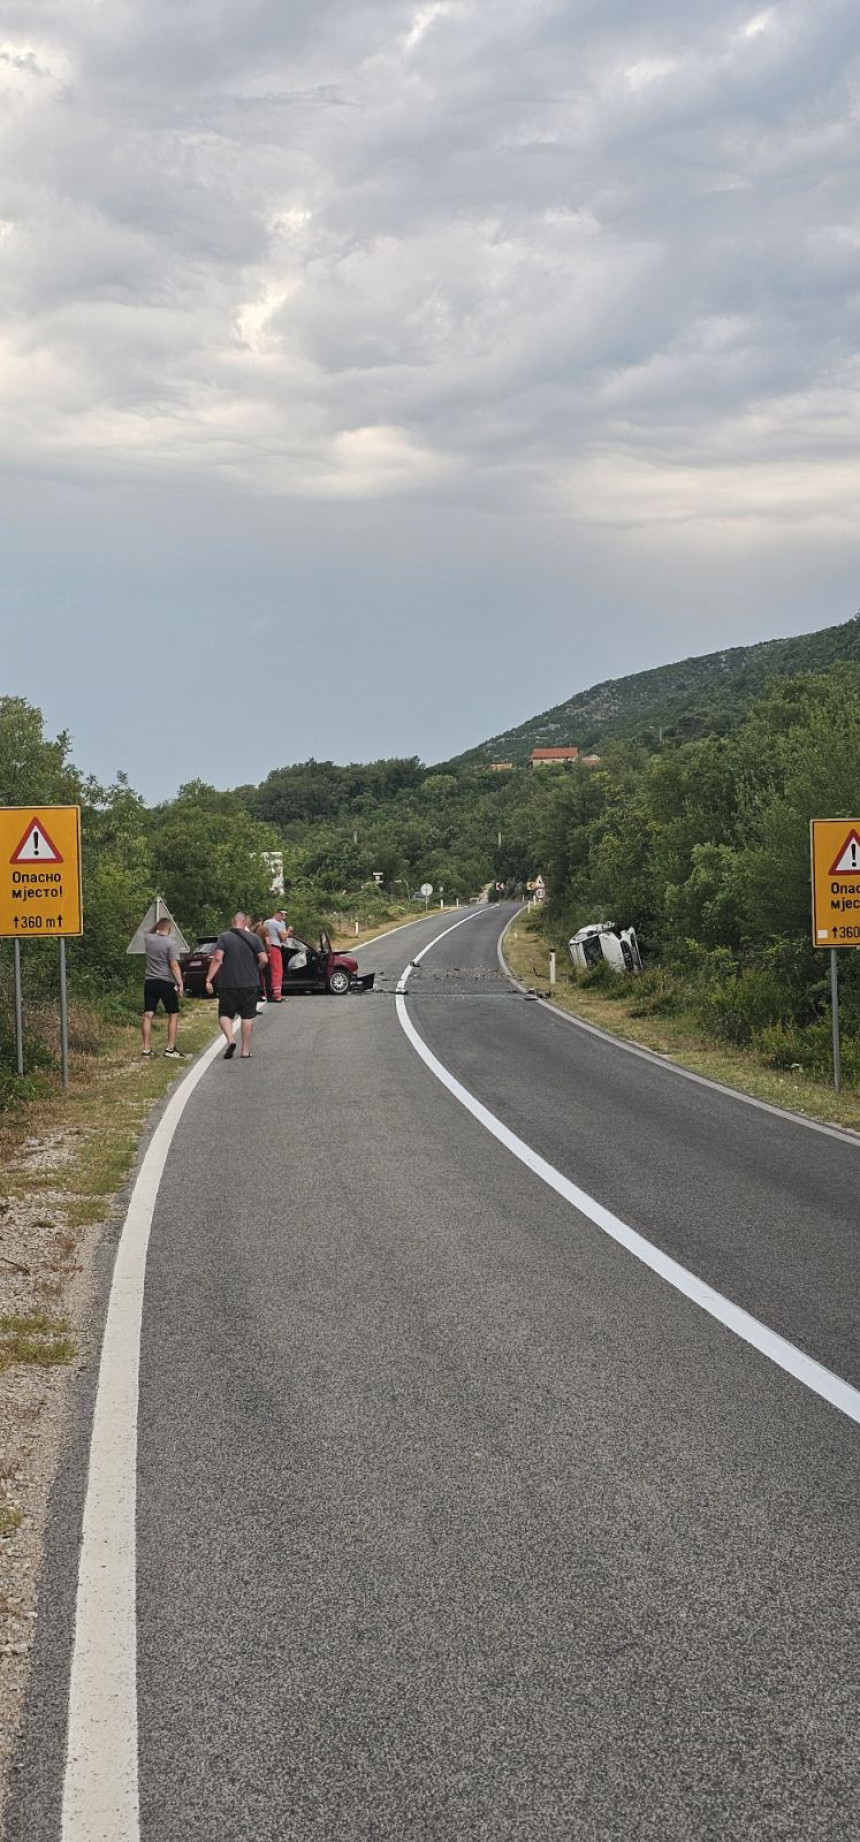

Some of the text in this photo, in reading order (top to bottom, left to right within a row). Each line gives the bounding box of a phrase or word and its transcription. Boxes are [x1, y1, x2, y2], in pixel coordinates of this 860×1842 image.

[12, 871, 62, 883] Опасно
[12, 885, 63, 901] мјесто!
[831, 897, 860, 912] мјес
[21, 916, 42, 928] 360
[839, 926, 860, 938] 360
